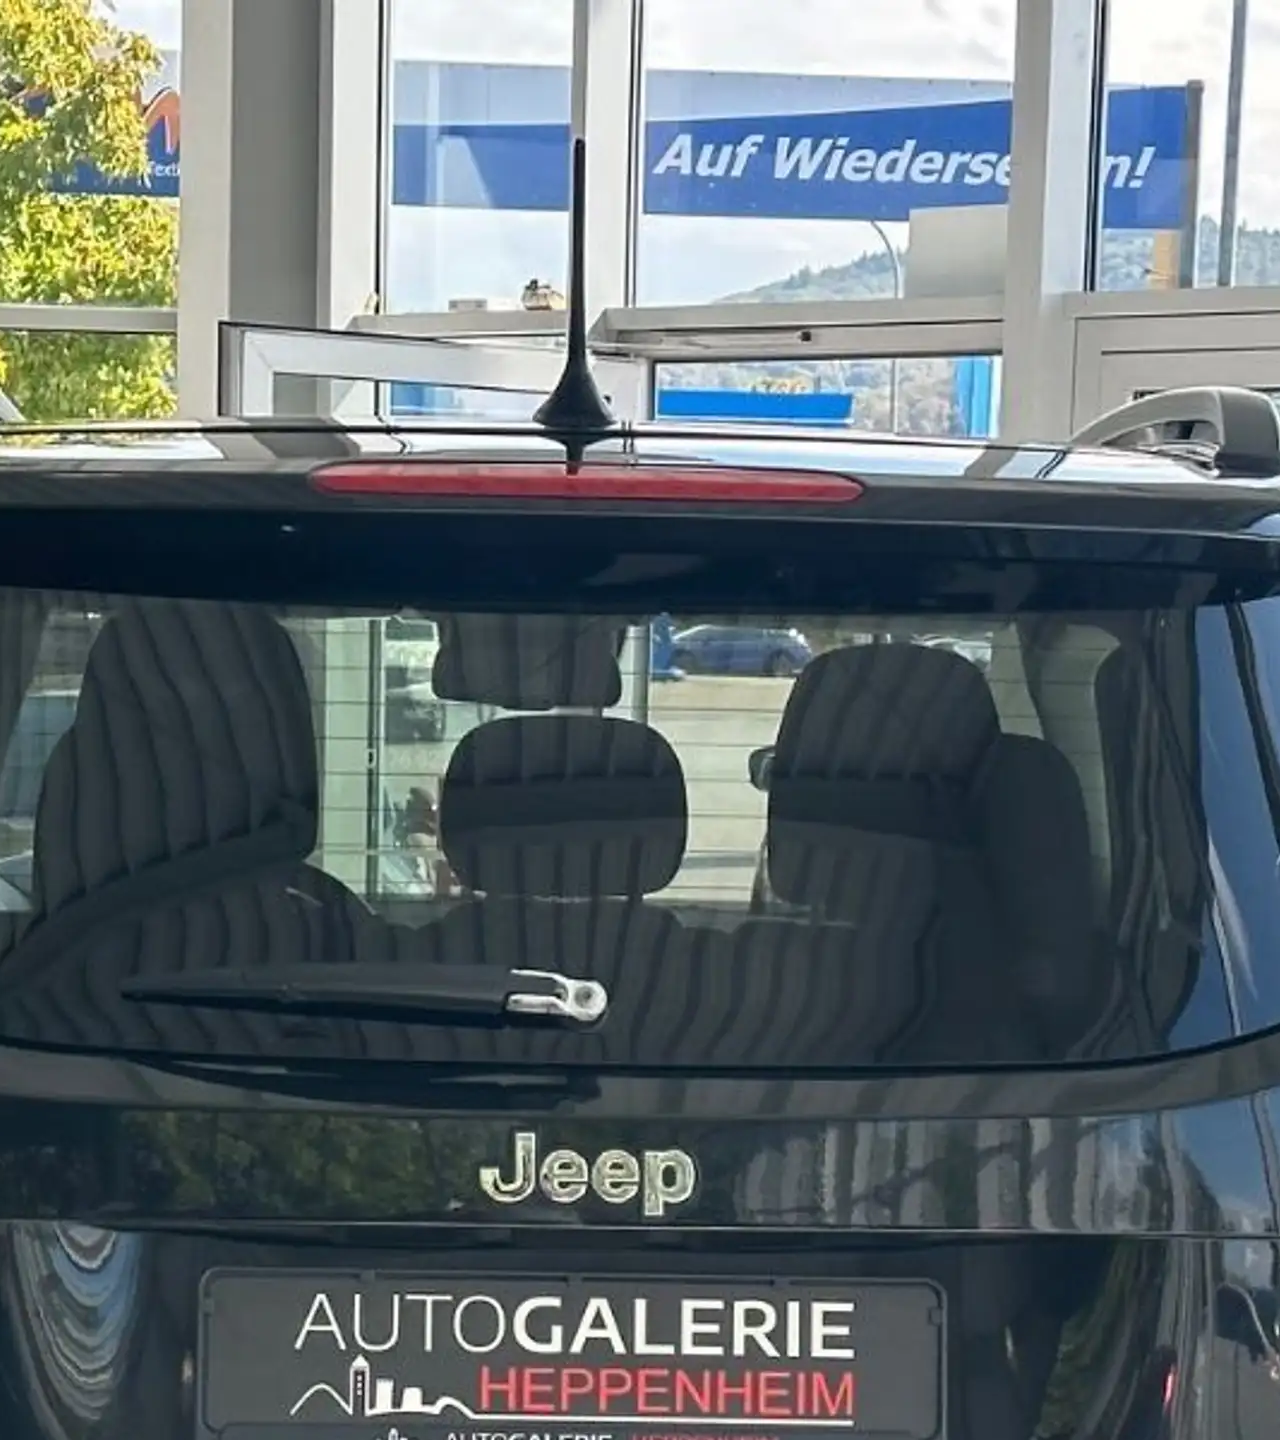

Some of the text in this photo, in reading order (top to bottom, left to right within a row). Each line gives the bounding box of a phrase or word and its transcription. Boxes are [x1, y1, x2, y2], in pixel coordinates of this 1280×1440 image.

[653, 133, 1155, 189] Auf Wiedersen!
[479, 1131, 698, 1217] Jeep
[294, 1293, 856, 1359] AUTOGALERIE
[480, 1365, 854, 1416] HEPPENHEIM
